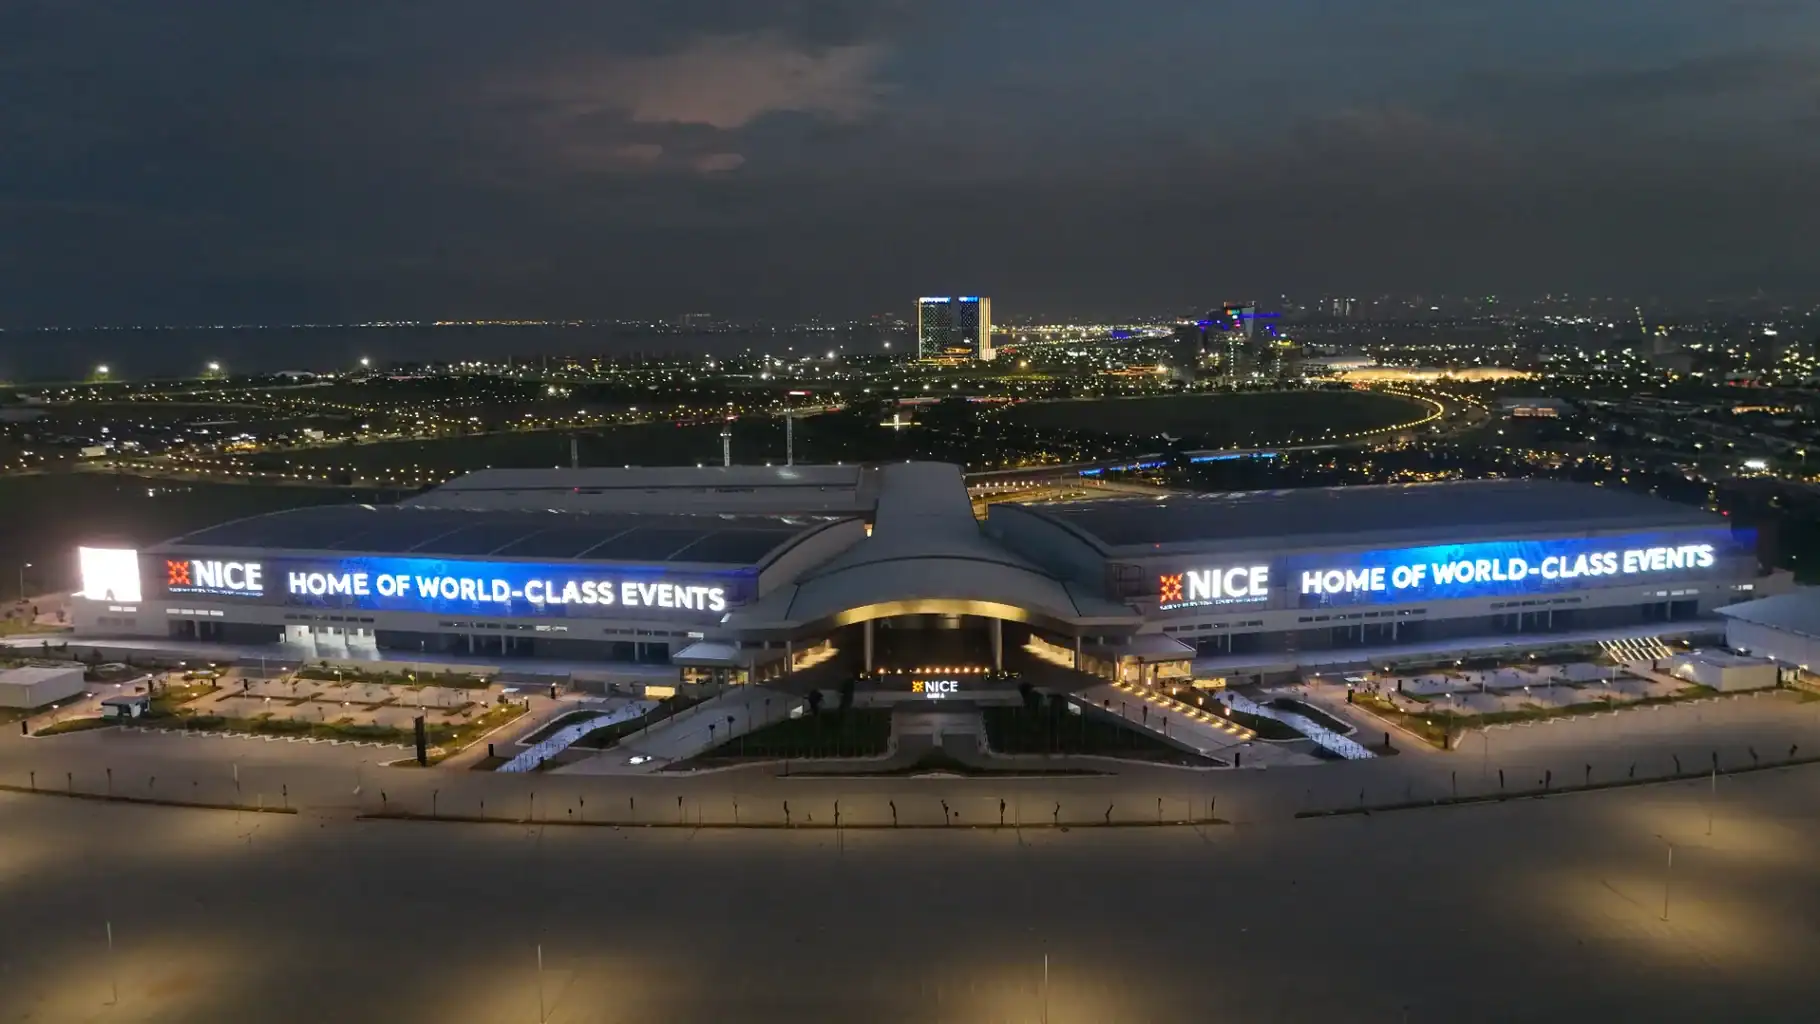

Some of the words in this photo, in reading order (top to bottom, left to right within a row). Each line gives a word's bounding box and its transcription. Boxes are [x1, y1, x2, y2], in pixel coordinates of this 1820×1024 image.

[191, 560, 263, 590] NICE
[1187, 566, 1269, 599] NICE
[1302, 568, 1386, 594] HOME
[1392, 564, 1427, 589] OF
[1432, 552, 1618, 585] WORLD-CLASS
[1623, 544, 1715, 573] EVENTS
[289, 572, 369, 596] HOME
[377, 574, 410, 597] OF
[415, 576, 615, 605] WORLD-CLASS
[621, 582, 727, 612] EVENTS
[925, 681, 958, 692] NICE
